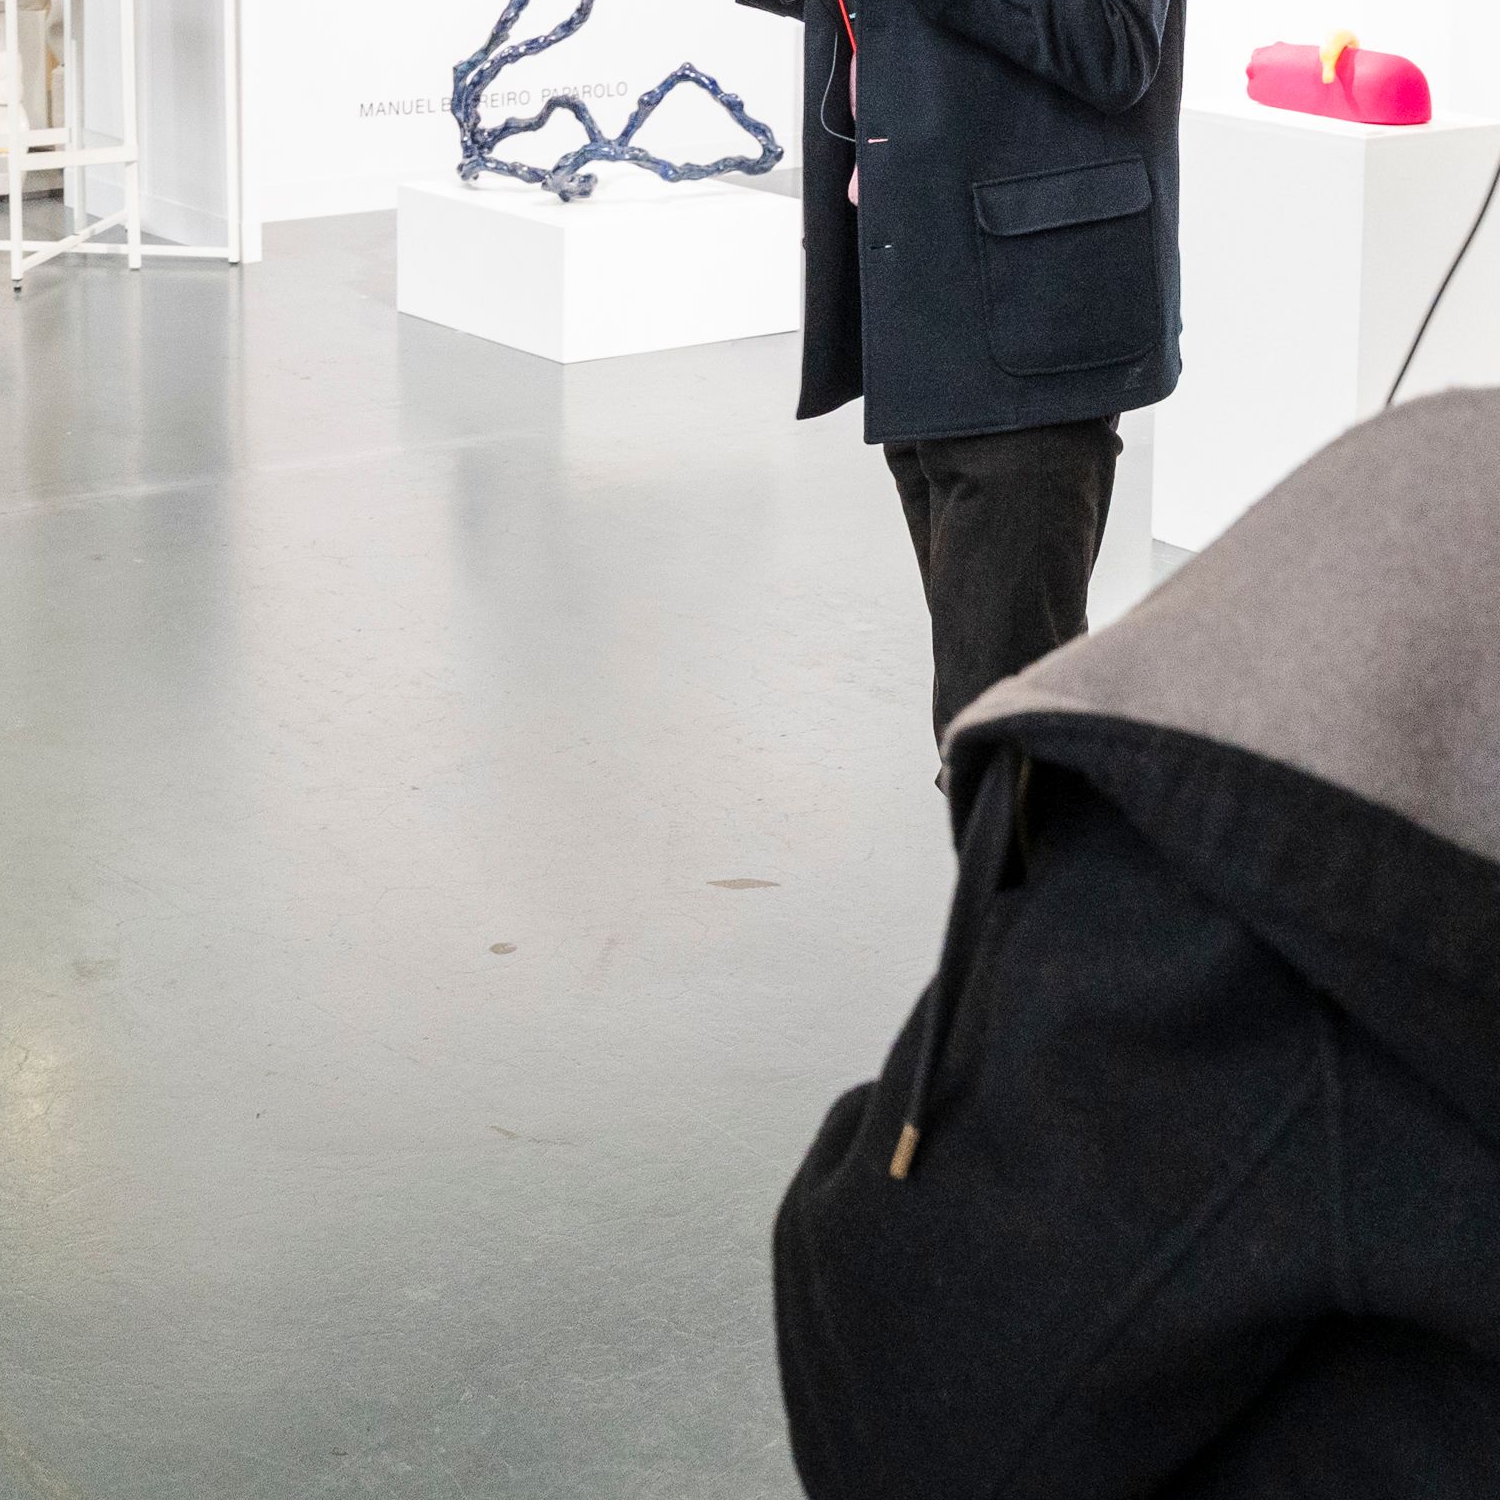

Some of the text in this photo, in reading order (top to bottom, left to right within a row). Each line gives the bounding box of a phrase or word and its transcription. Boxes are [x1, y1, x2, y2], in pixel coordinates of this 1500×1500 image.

[359, 81, 628, 117] MANUEL BREIRO PAPAROLO
